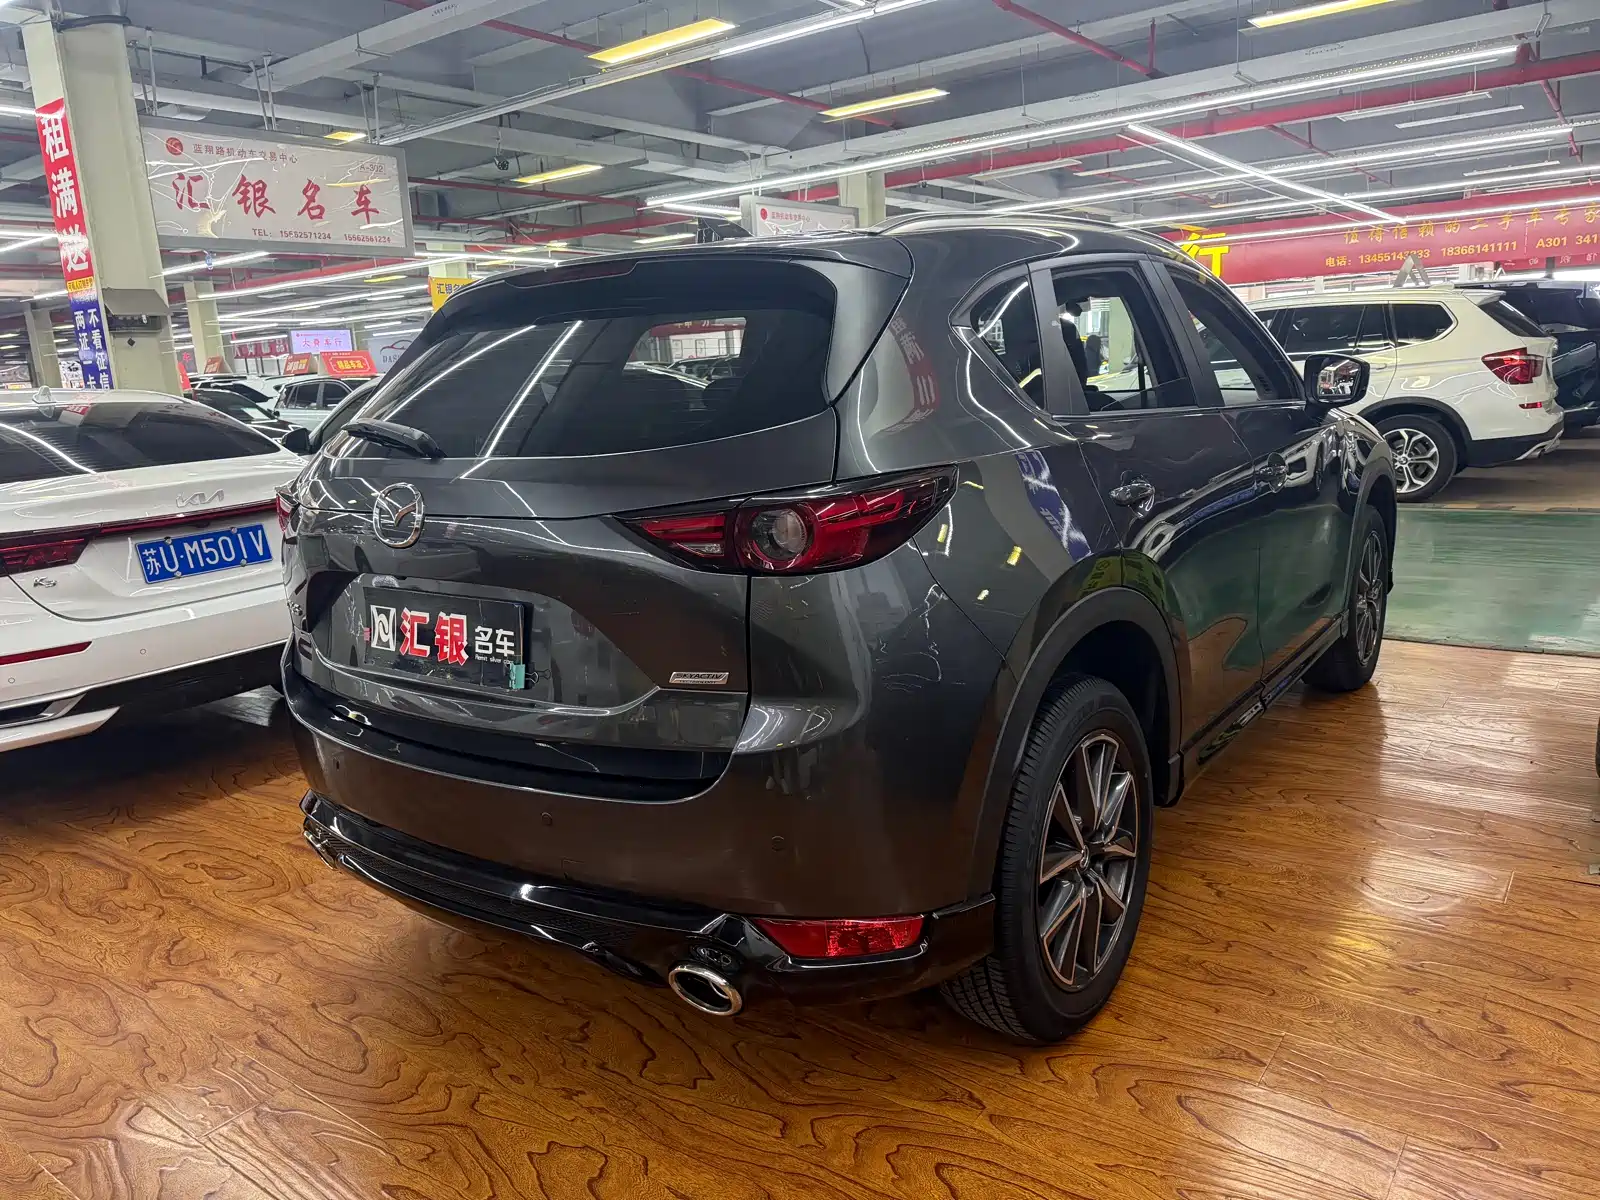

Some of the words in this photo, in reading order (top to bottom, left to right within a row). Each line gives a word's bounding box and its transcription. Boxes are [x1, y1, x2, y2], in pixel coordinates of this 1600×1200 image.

[192, 143, 298, 164] 蓝翔路机动车交易中心
[42, 116, 89, 272] 租满送
[171, 172, 380, 225] 汇银名车
[1441, 240, 1517, 258] 18366141111
[1536, 236, 1568, 249] A301
[382, 354, 400, 363] DAS
